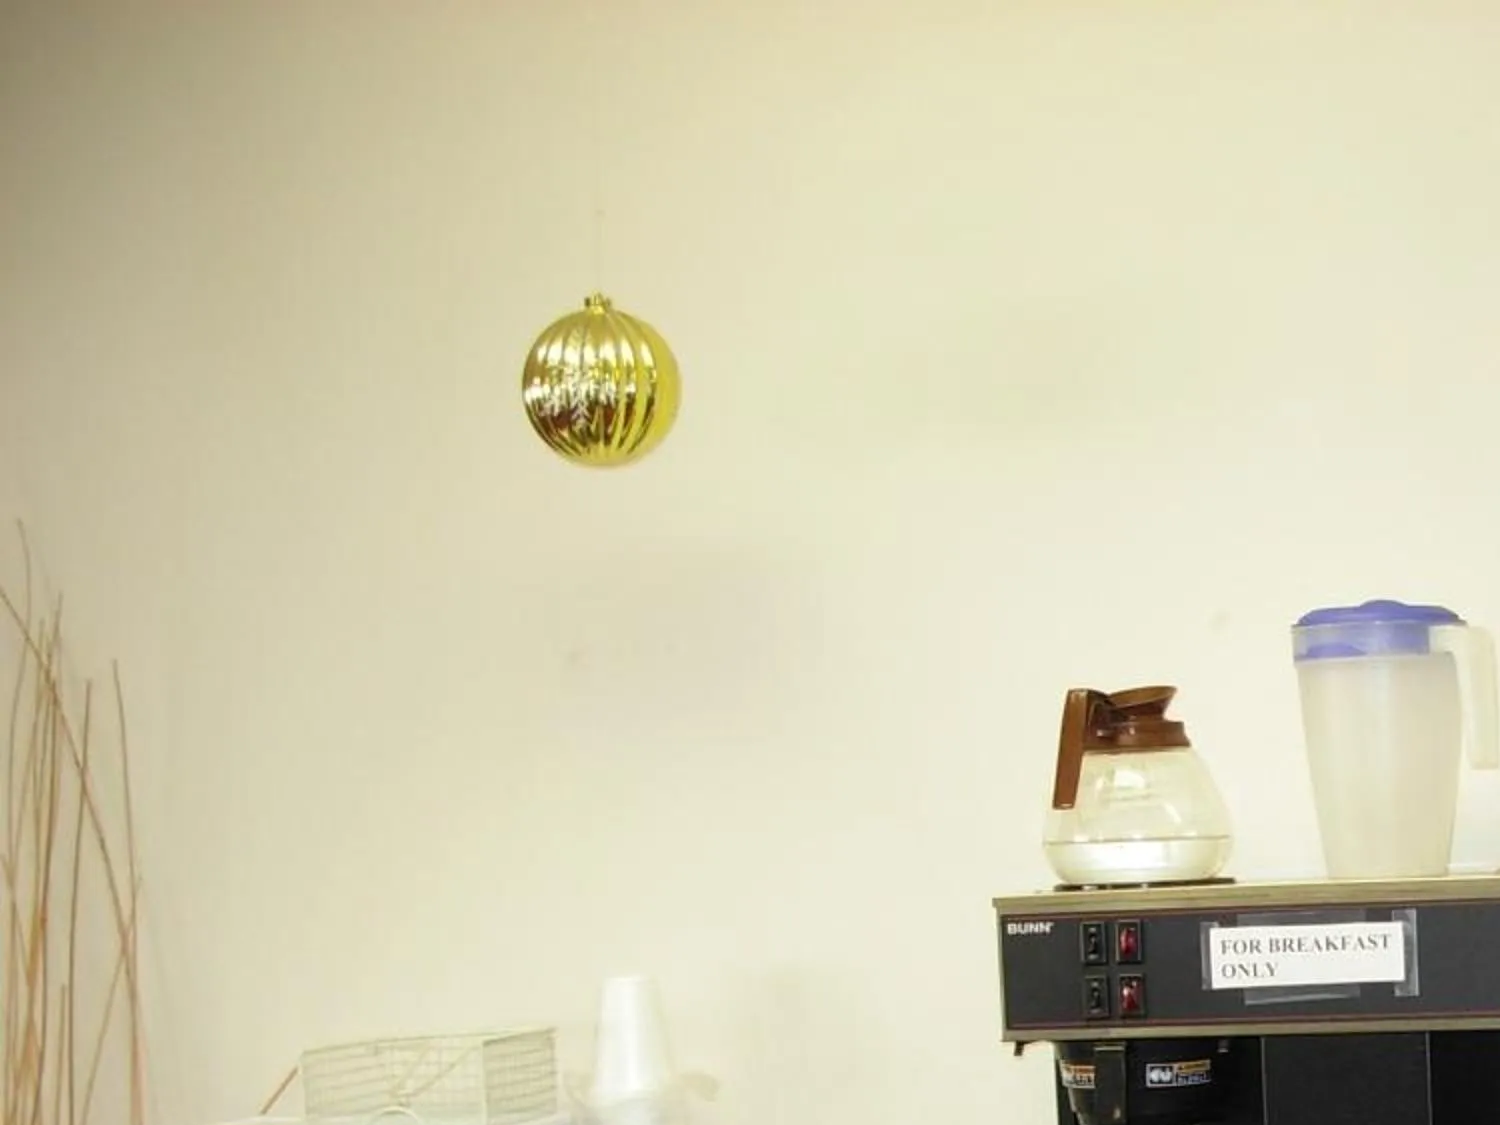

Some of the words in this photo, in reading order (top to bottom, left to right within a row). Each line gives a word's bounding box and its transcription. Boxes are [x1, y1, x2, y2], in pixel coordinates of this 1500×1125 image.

[1007, 921, 1052, 936] BUNN
[1220, 938, 1263, 956] FOR
[1268, 933, 1393, 954] BREAKFAST
[1220, 961, 1279, 979] ONLY
